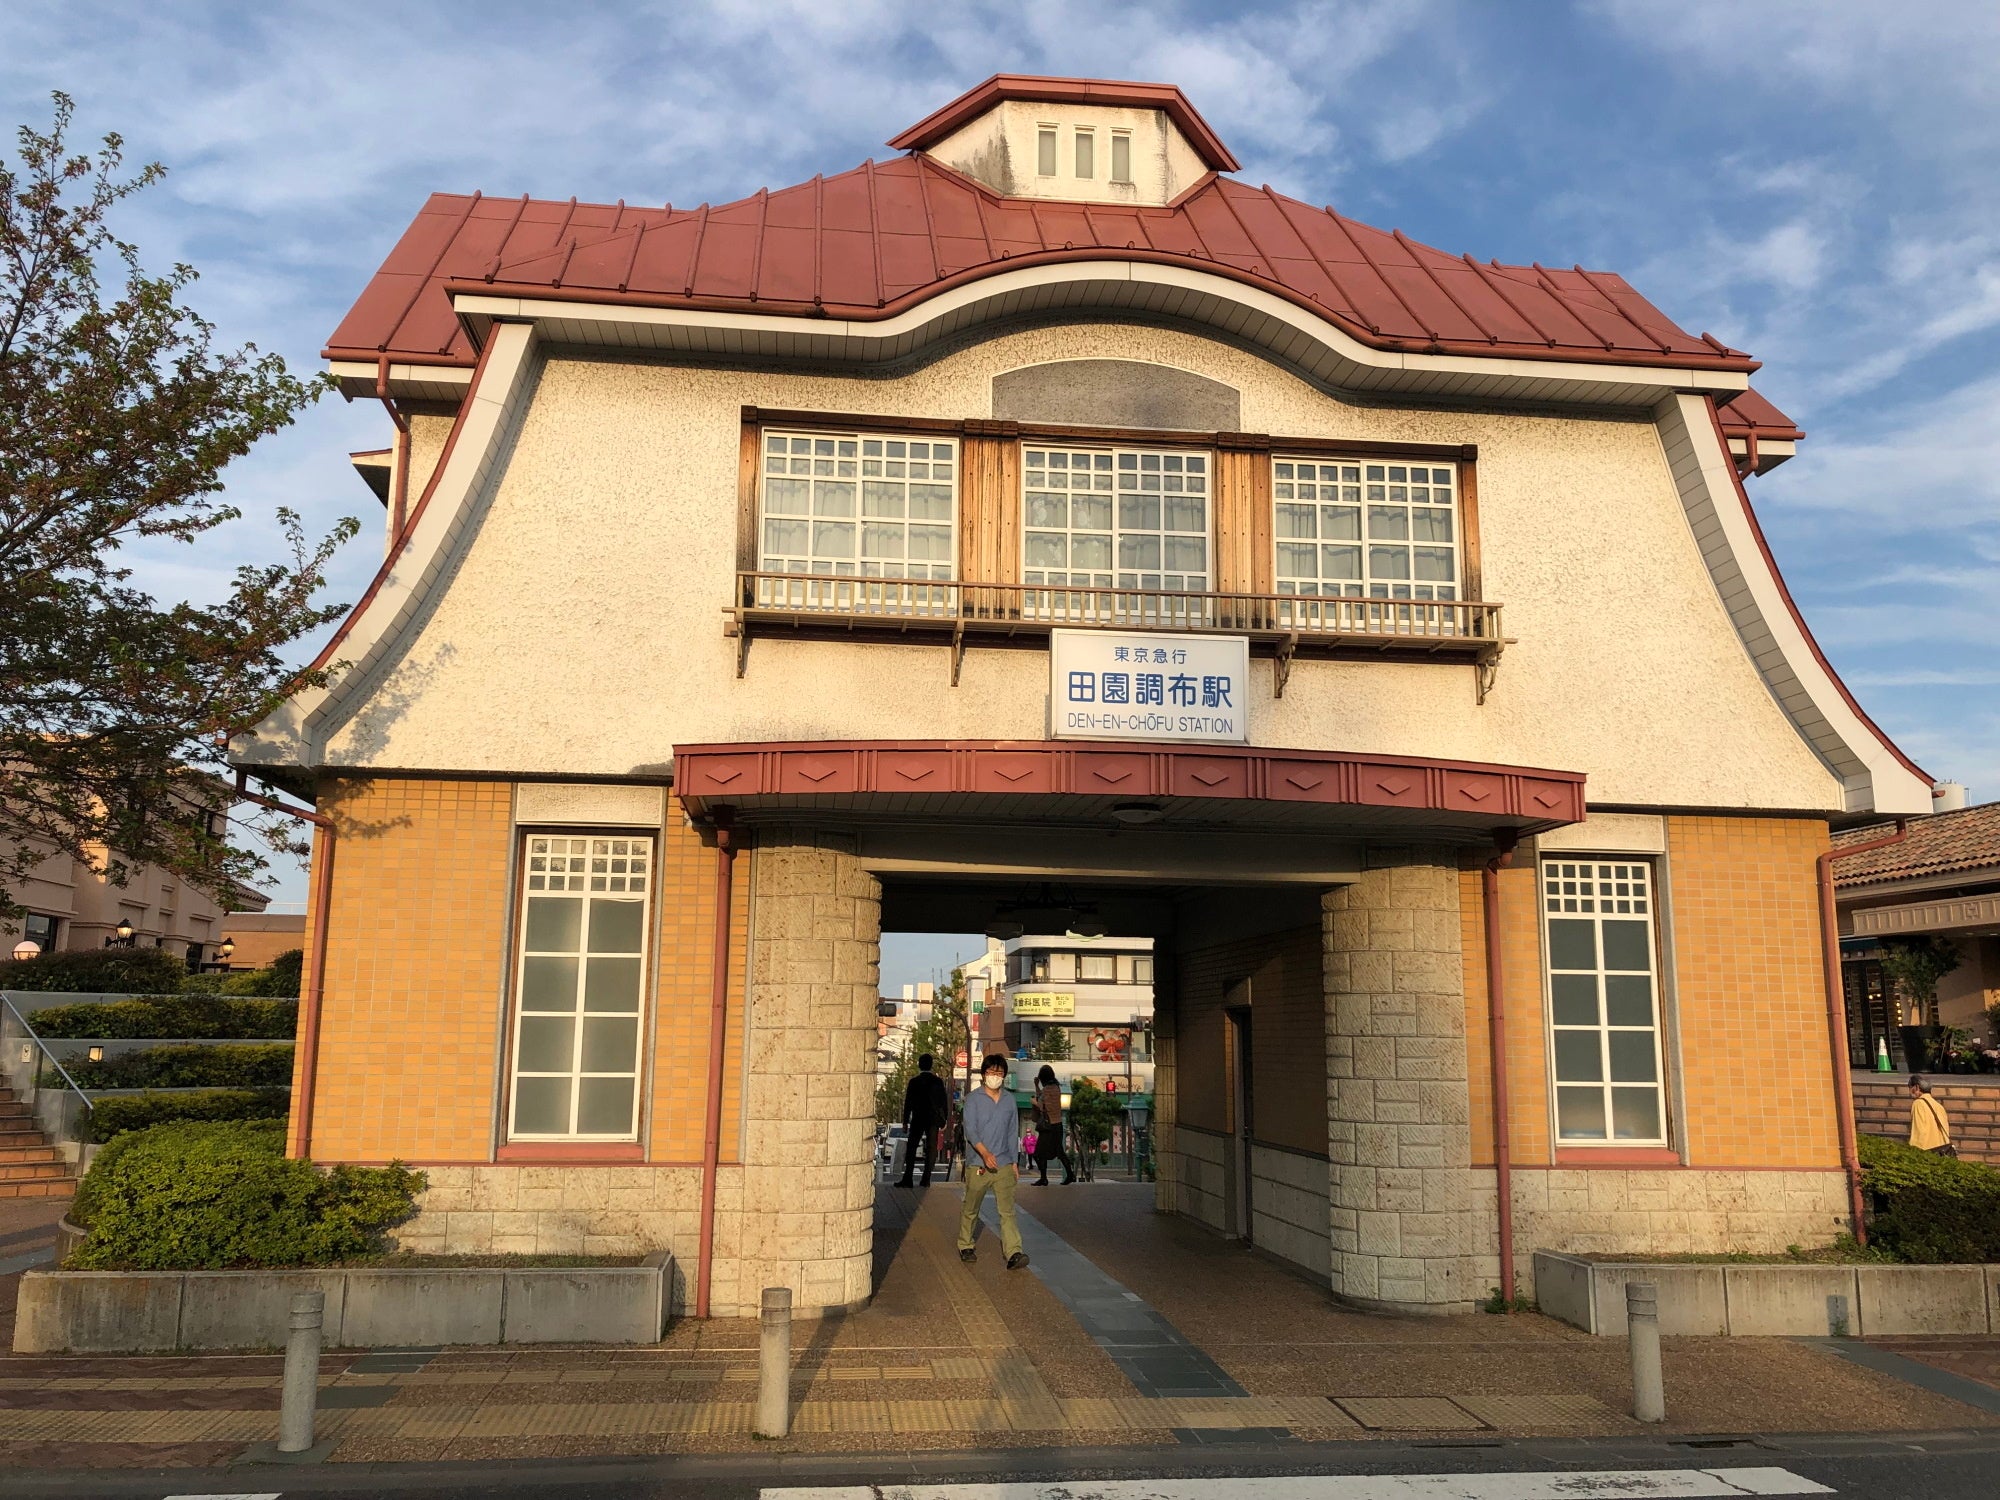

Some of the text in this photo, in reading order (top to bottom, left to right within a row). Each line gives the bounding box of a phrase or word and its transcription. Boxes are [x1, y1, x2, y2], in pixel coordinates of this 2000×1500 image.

[1114, 646, 1187, 665] 東京急行
[1068, 671, 1233, 708] 田園調布駅
[1068, 712, 1233, 734] DEN-EN-CHŌFU STATION
